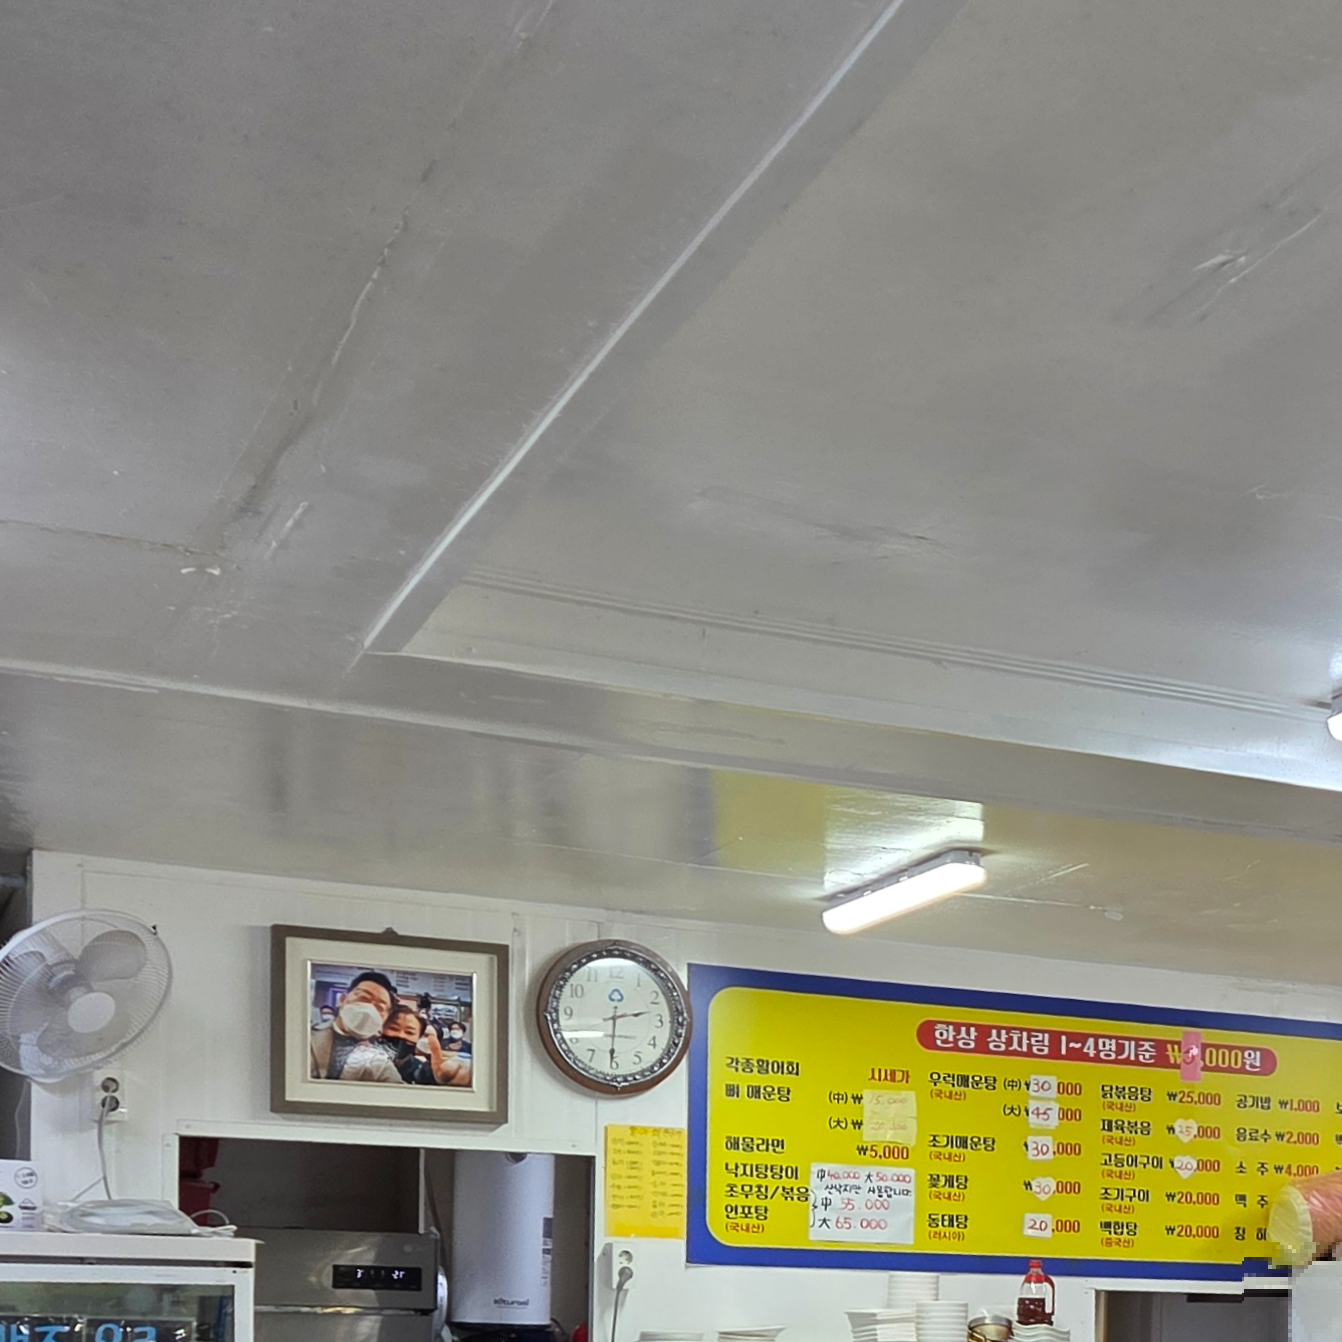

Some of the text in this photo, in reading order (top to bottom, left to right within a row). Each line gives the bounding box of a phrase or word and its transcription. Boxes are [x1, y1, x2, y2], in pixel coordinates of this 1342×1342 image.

[587, 968, 598, 982] 11
[608, 967, 623, 979] 12
[636, 974, 641, 987] 1
[570, 984, 584, 998] 10
[650, 991, 659, 1005] 2
[564, 1007, 573, 1020] 9
[655, 1015, 663, 1028] 3
[647, 1036, 656, 1049] 4
[935, 1024, 976, 1048] 한상
[987, 1030, 1050, 1055] 상차림
[1061, 1035, 1156, 1063] 1~4명기준
[586, 1049, 595, 1062] 7
[633, 1052, 642, 1065] 5
[868, 1068, 910, 1083] 시세가
[928, 1072, 997, 1090] 우럭매운탕
[1003, 1079, 1022, 1091] (中)
[747, 1085, 791, 1102] 매운탕
[828, 1091, 848, 1104] (中)
[1101, 1085, 1221, 1105] 닭볶음탕 ₩25,000
[1236, 1094, 1271, 1110] 공기밥
[1003, 1104, 1021, 1117] (大)
[828, 1117, 847, 1130] (大)
[1101, 1119, 1151, 1136] 제육볶음
[928, 1135, 996, 1151] 조기매운탕
[1236, 1128, 1319, 1146] 음료수 ₩2,000
[725, 1136, 909, 1160] 해물라면 ₩5,000
[1101, 1153, 1163, 1169] 고등어구이
[725, 1162, 798, 1181] 낙지탕탕이
[1257, 1162, 1269, 1176] 주
[928, 1174, 969, 1190] 꽃게탕
[725, 1183, 810, 1203] 초무침/볶음
[1099, 1187, 1220, 1206] 조기구이 ₩20,000
[1257, 1195, 1268, 1209] 주
[725, 1204, 768, 1221] 연포탕
[927, 1214, 969, 1229] 동태탕
[1100, 1221, 1220, 1239] 백합탕 ₩20,000
